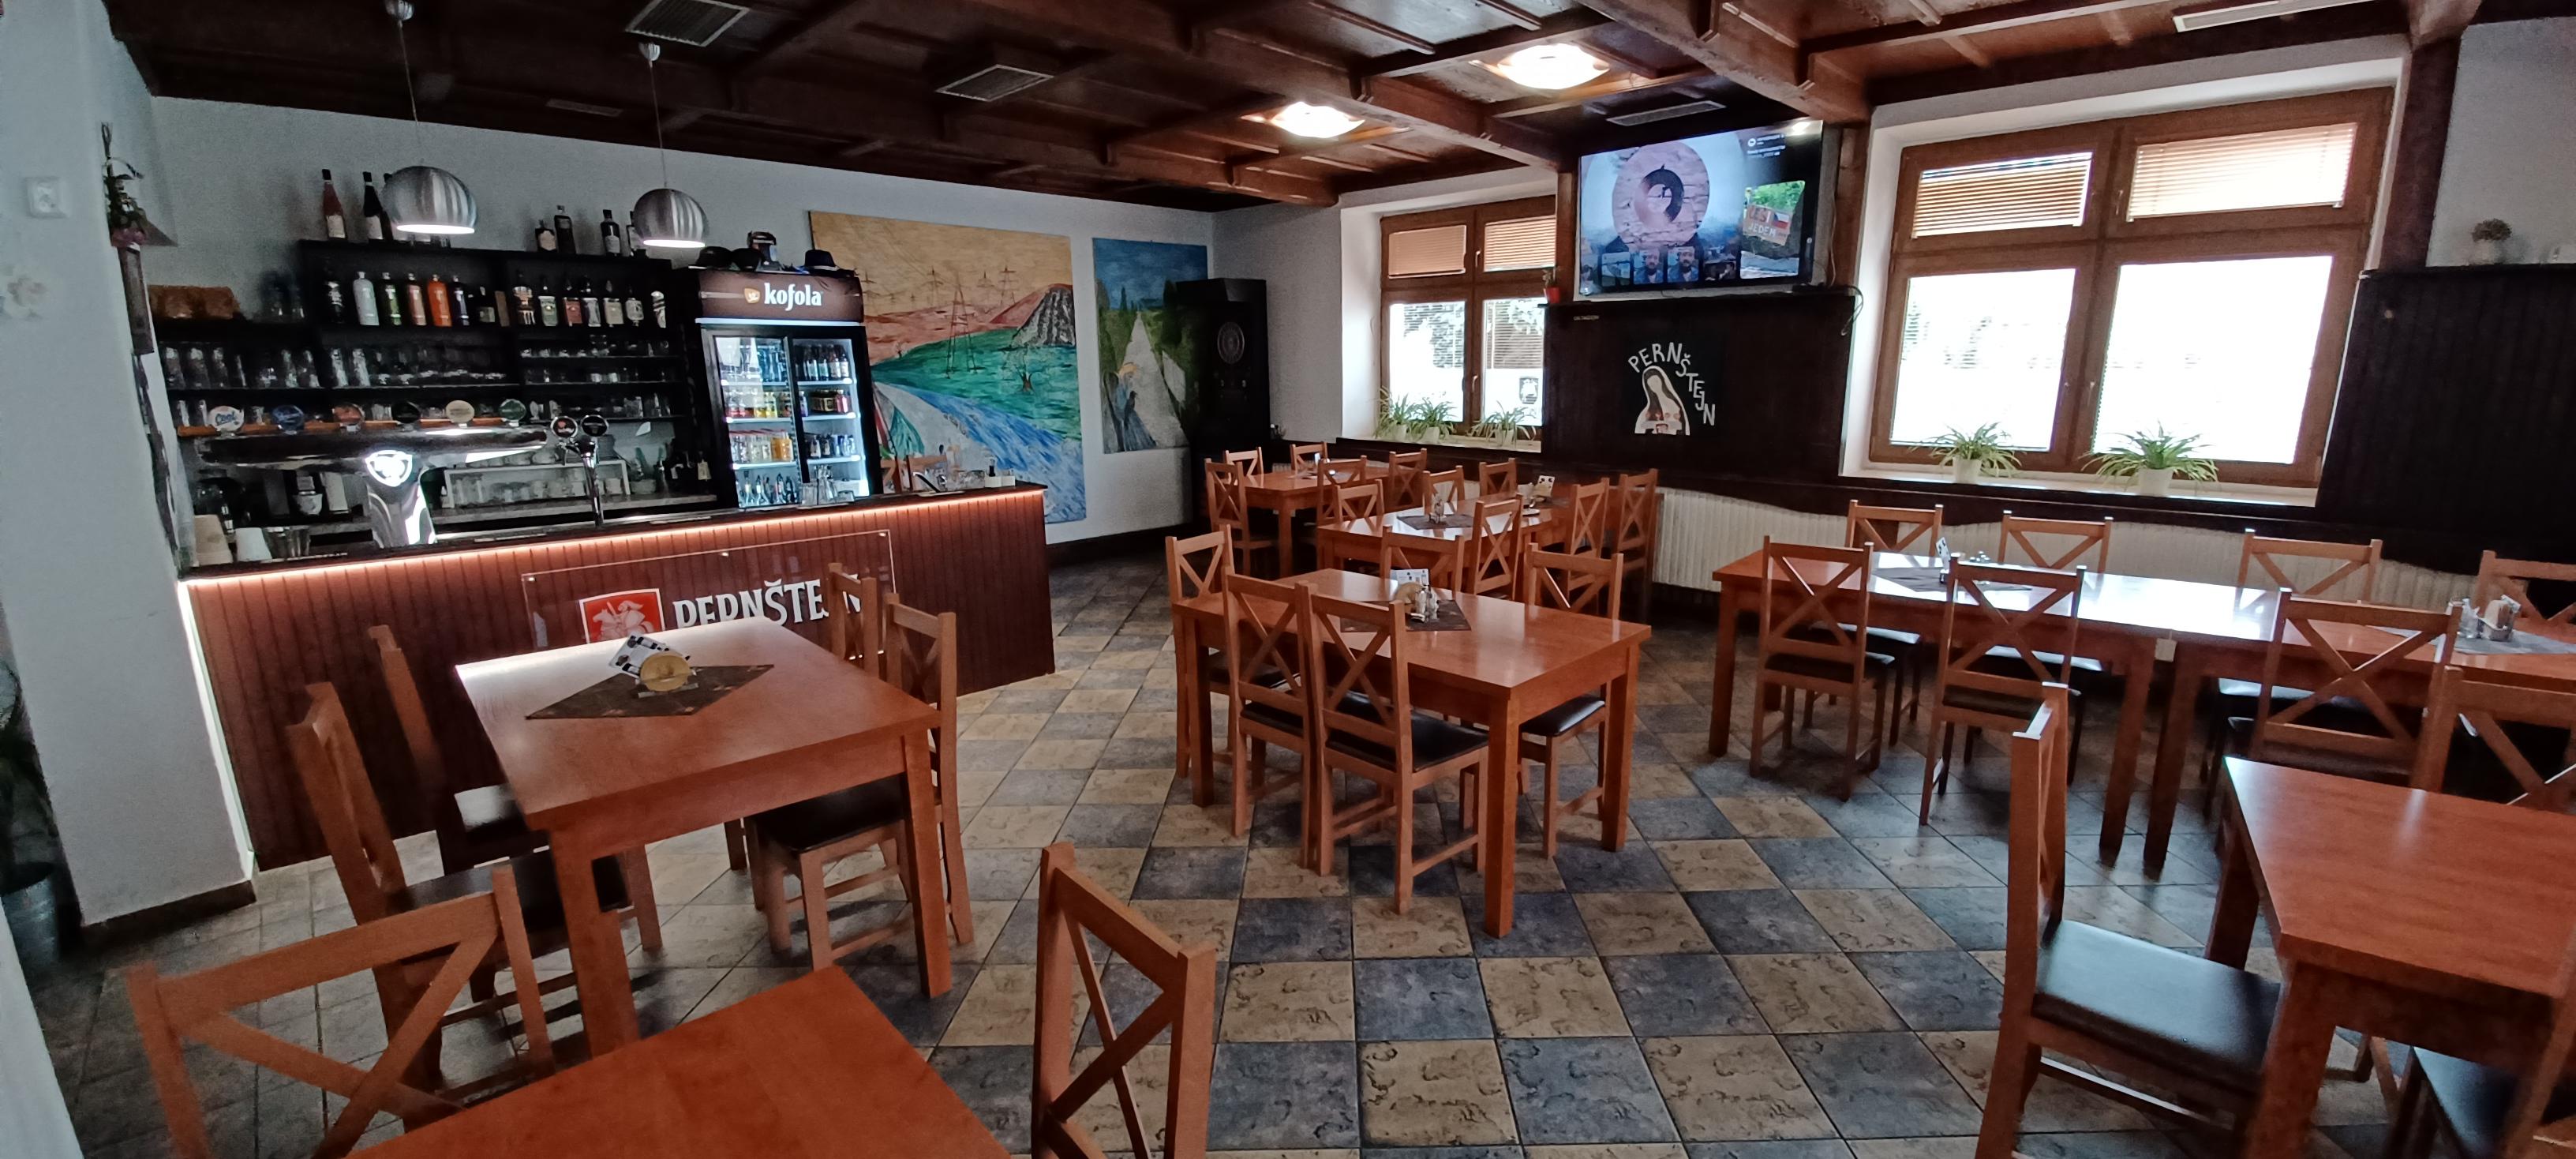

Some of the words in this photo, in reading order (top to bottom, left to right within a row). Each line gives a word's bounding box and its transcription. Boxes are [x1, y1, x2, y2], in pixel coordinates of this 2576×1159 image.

[1747, 222, 1777, 238] JEDEM
[764, 282, 822, 311] kofola
[1627, 342, 1716, 426] PERNŠTEJN
